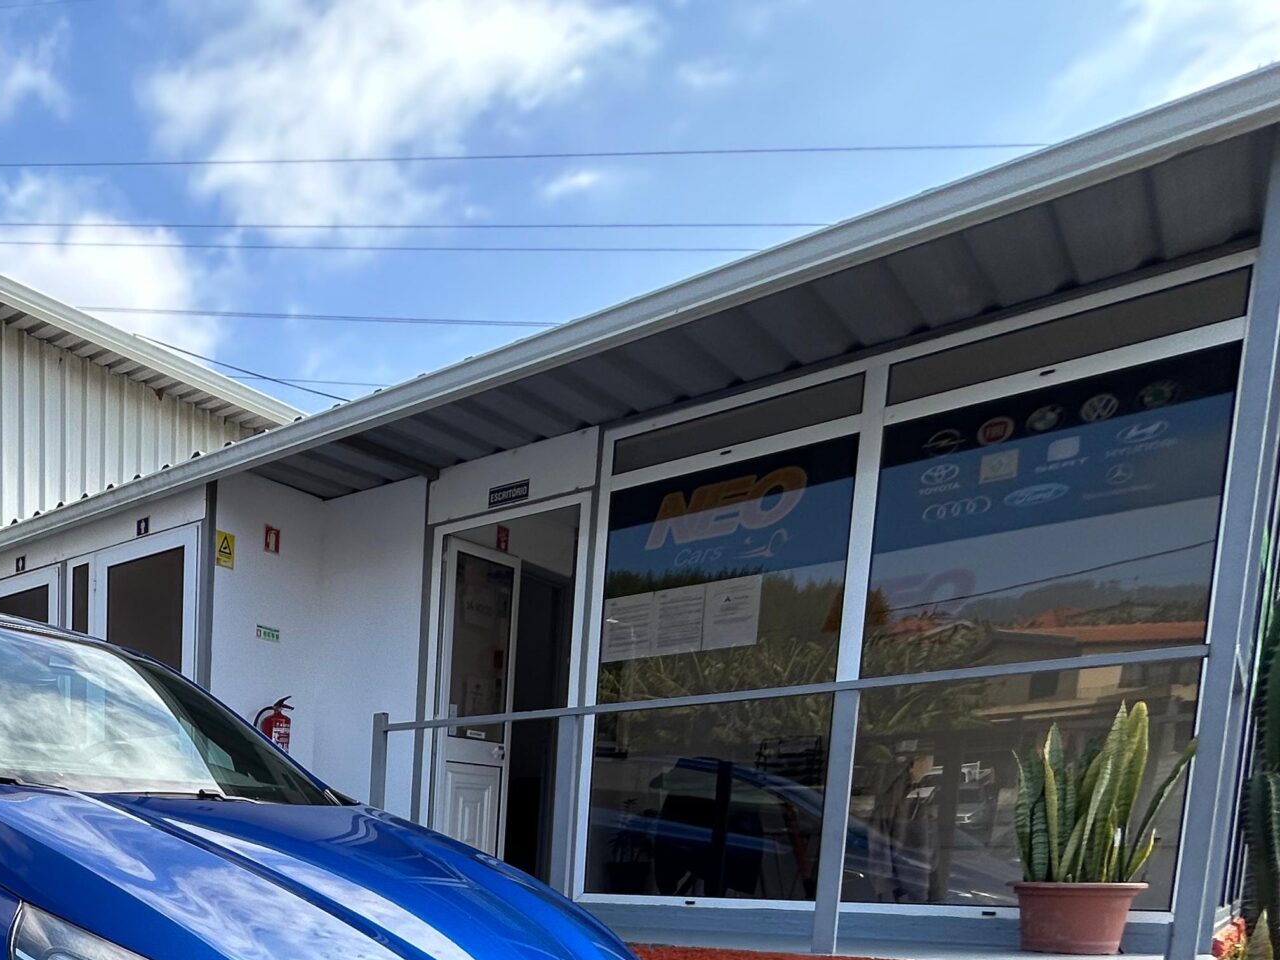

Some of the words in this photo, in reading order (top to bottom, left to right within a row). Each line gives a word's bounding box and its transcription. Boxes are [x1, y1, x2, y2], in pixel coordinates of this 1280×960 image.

[918, 482, 960, 495] TOYOTA
[644, 465, 808, 550] NEO
[673, 546, 724, 567] Cars
